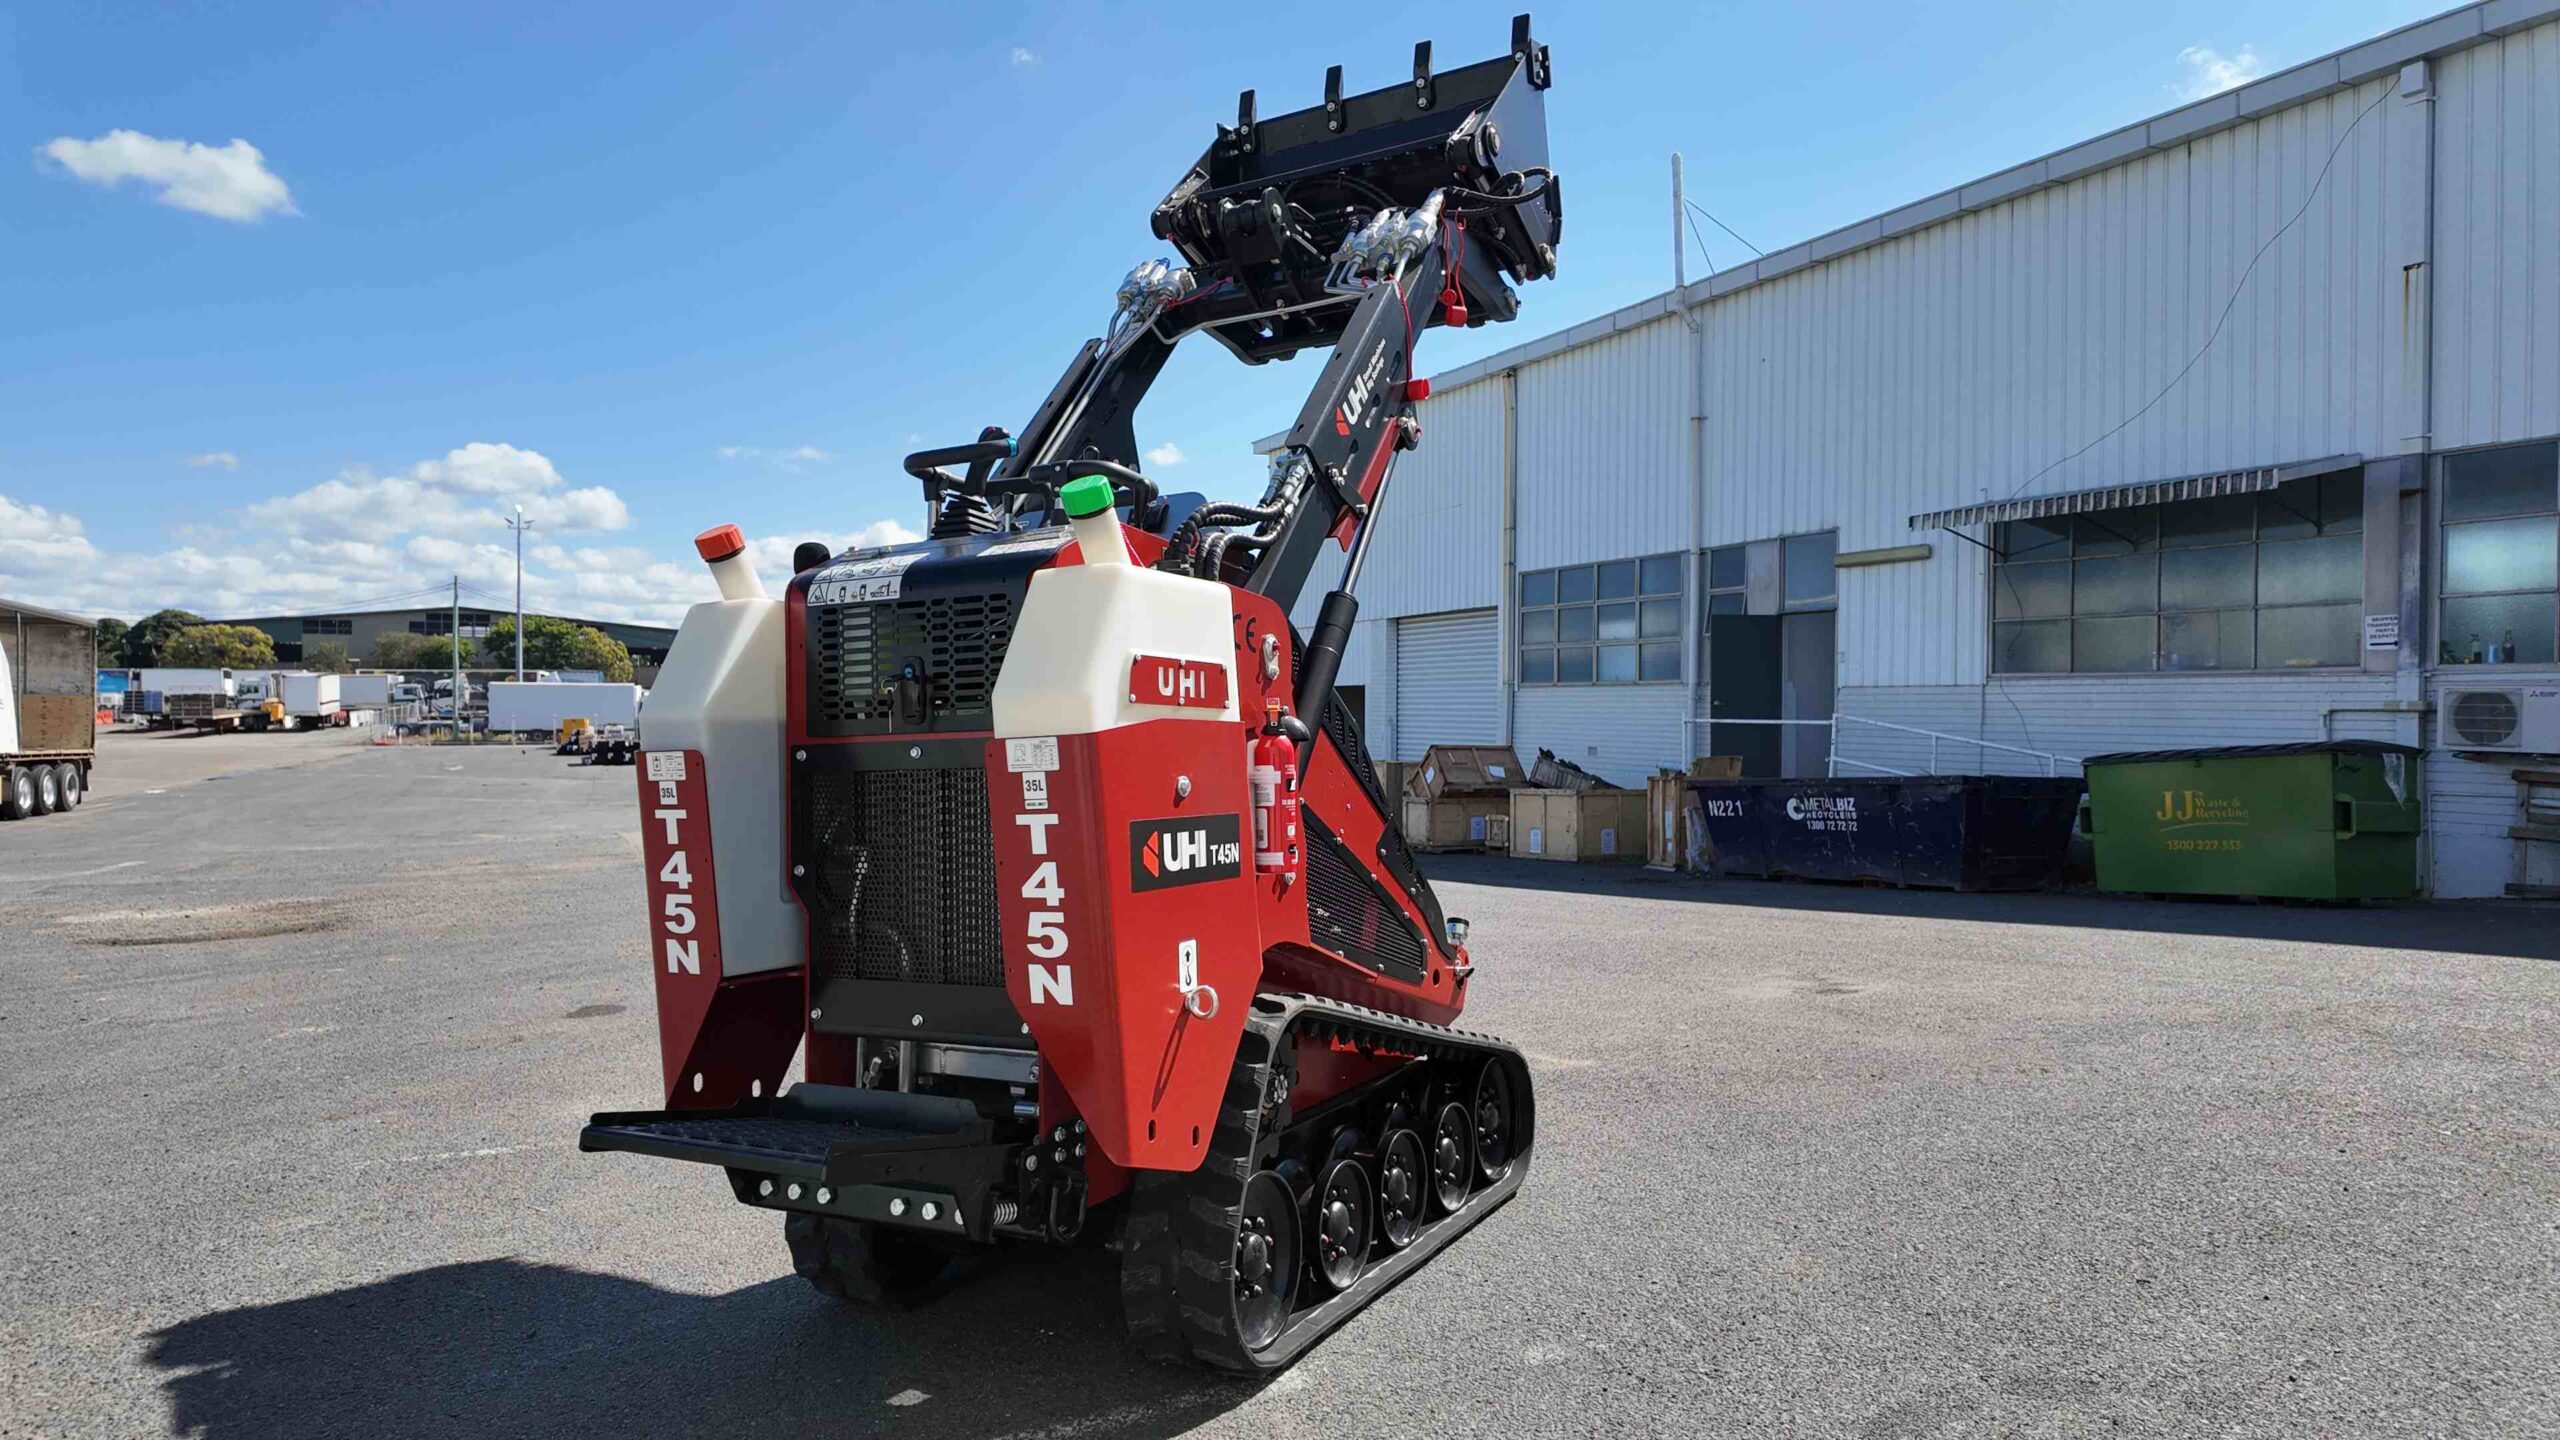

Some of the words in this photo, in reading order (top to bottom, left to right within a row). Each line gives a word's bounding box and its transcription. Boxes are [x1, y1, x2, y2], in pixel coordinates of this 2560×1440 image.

[1342, 374, 1369, 425] UHI
[1158, 666, 1206, 699] UHI
[661, 787, 676, 799] 35L
[1025, 779, 1044, 792] 35L
[1708, 800, 1743, 817] N221
[1804, 797, 1856, 811] METALBIZ
[1806, 820, 1825, 831] 1300
[1826, 820, 1836, 831] 72
[1837, 820, 1847, 831] 72
[1848, 820, 1858, 832] 72
[1163, 830, 1207, 872] UHI
[1210, 842, 1240, 866] T45N
[654, 809, 701, 975] T45N
[1015, 813, 1074, 1006] T45N
